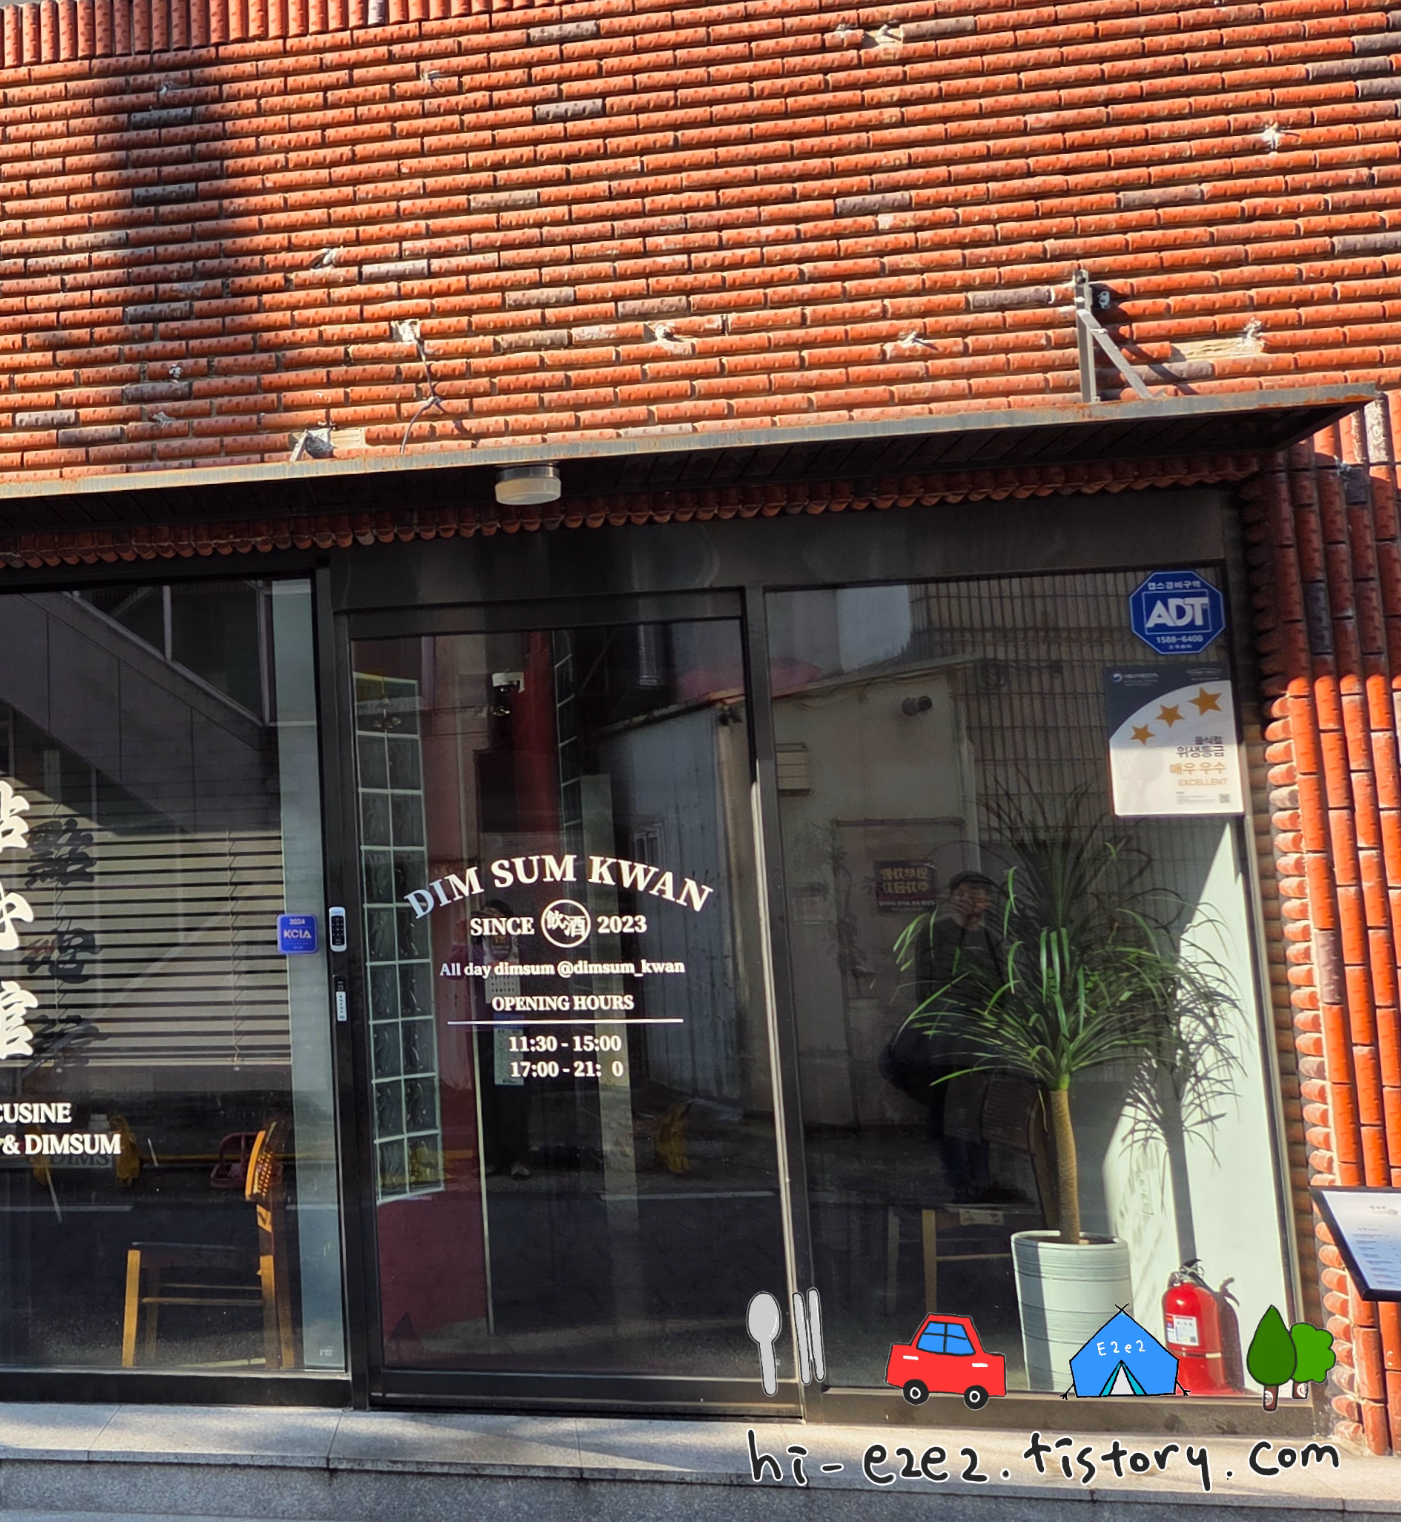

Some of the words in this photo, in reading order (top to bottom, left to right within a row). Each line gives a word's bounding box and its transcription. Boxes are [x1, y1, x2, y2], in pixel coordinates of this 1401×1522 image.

[1145, 597, 1209, 628] ADT
[1156, 634, 1203, 644] 1588-6400
[1176, 746, 1225, 758] 위생등급
[1170, 763, 1196, 775] 매우
[1198, 761, 1227, 774] 우수
[1178, 777, 1228, 787] EXCELLENT
[403, 866, 484, 919] DIM
[490, 854, 577, 888] SUM
[588, 855, 713, 912] KWAN
[470, 917, 535, 936] SINCE
[597, 915, 647, 933] 2023
[283, 929, 312, 939] KCIA
[440, 963, 461, 976] All
[464, 962, 491, 980] day
[494, 961, 555, 975] dimsum
[557, 958, 685, 978] @dimsum_kwan
[492, 995, 570, 1012] OPENING
[573, 994, 634, 1010] HOURS
[509, 1036, 557, 1052] 11:30
[573, 1035, 622, 1051] 15:00
[510, 1061, 559, 1077] 17:00
[574, 1061, 624, 1077] 21:0
[2, 1135, 20, 1155] &
[24, 1133, 121, 1155] DIMSUM
